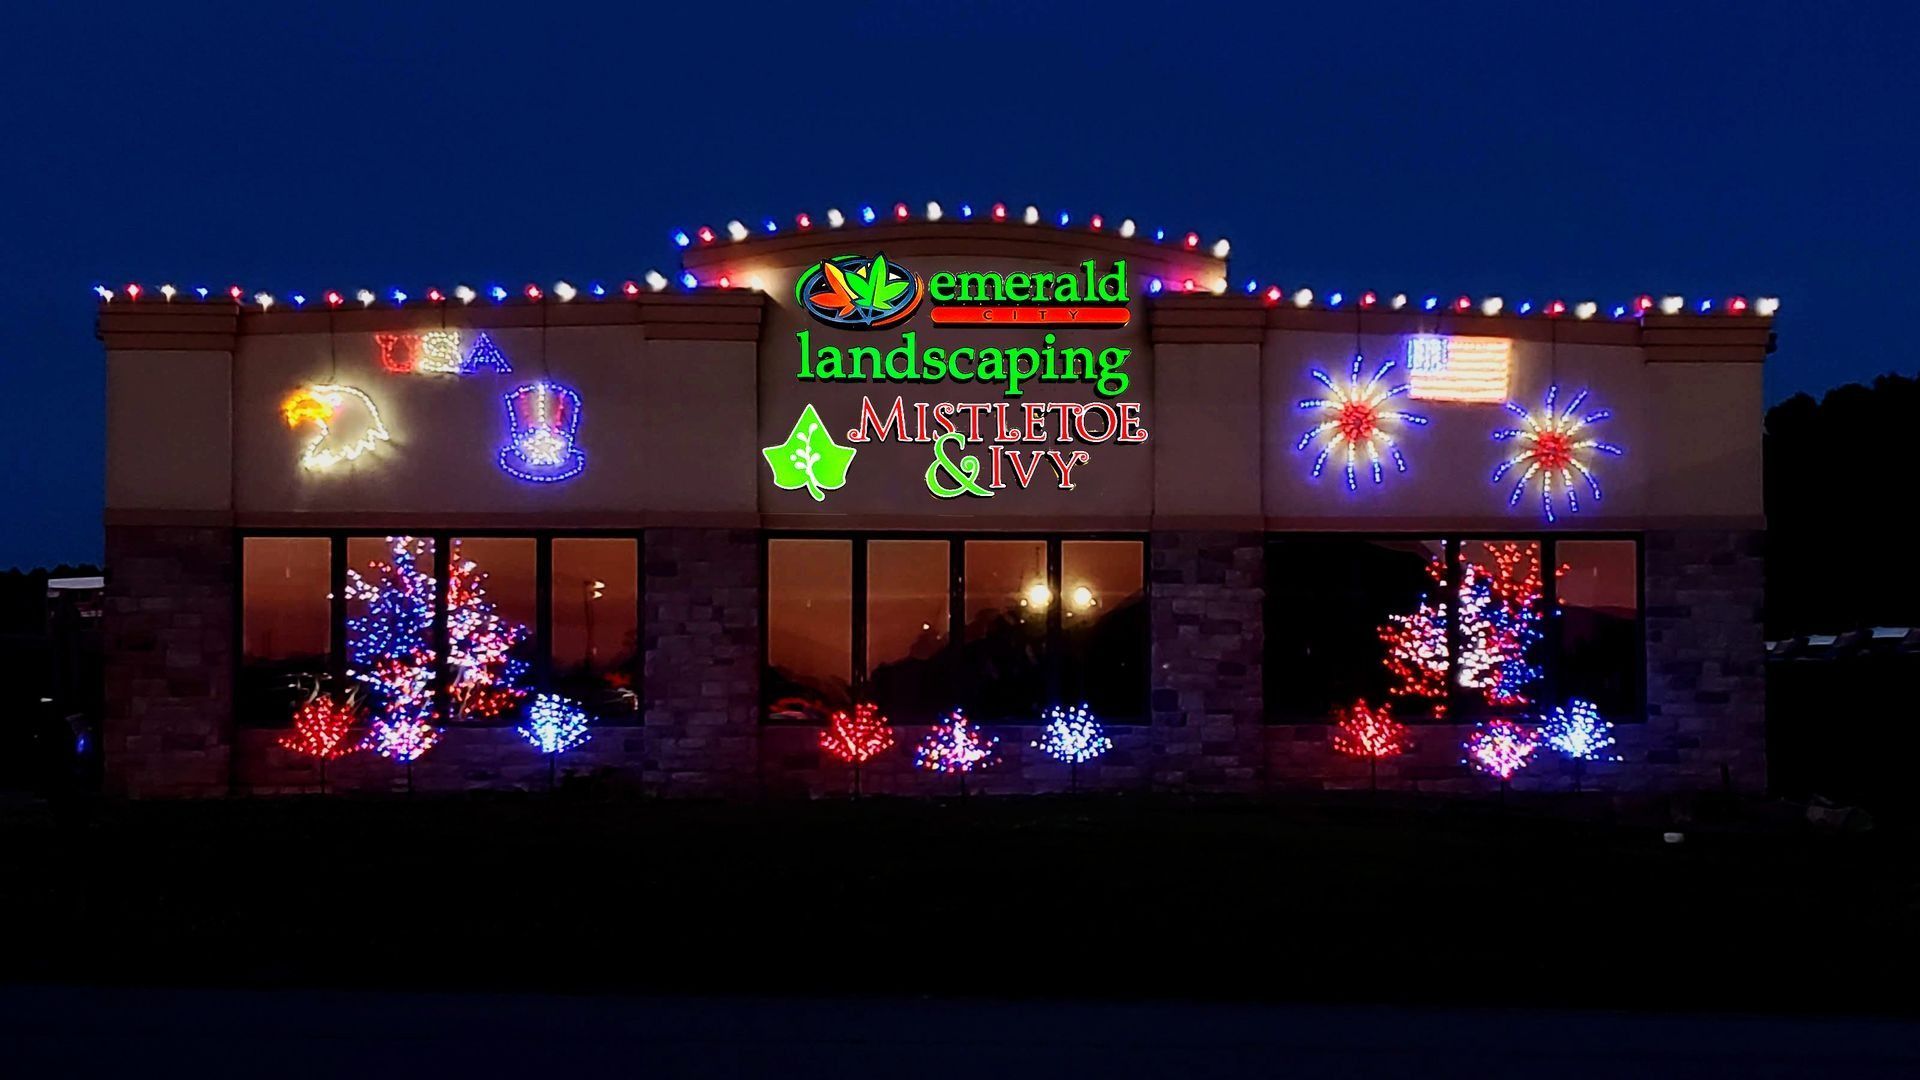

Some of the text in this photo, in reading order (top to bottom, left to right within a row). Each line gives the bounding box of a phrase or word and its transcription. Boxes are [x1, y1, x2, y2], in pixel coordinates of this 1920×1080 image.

[929, 258, 1130, 302] emerald
[982, 309, 1080, 321] CITY
[374, 331, 513, 375] USA
[796, 330, 1131, 397] landscaping
[847, 395, 1149, 444] MISTLETOE
[925, 432, 994, 498] &
